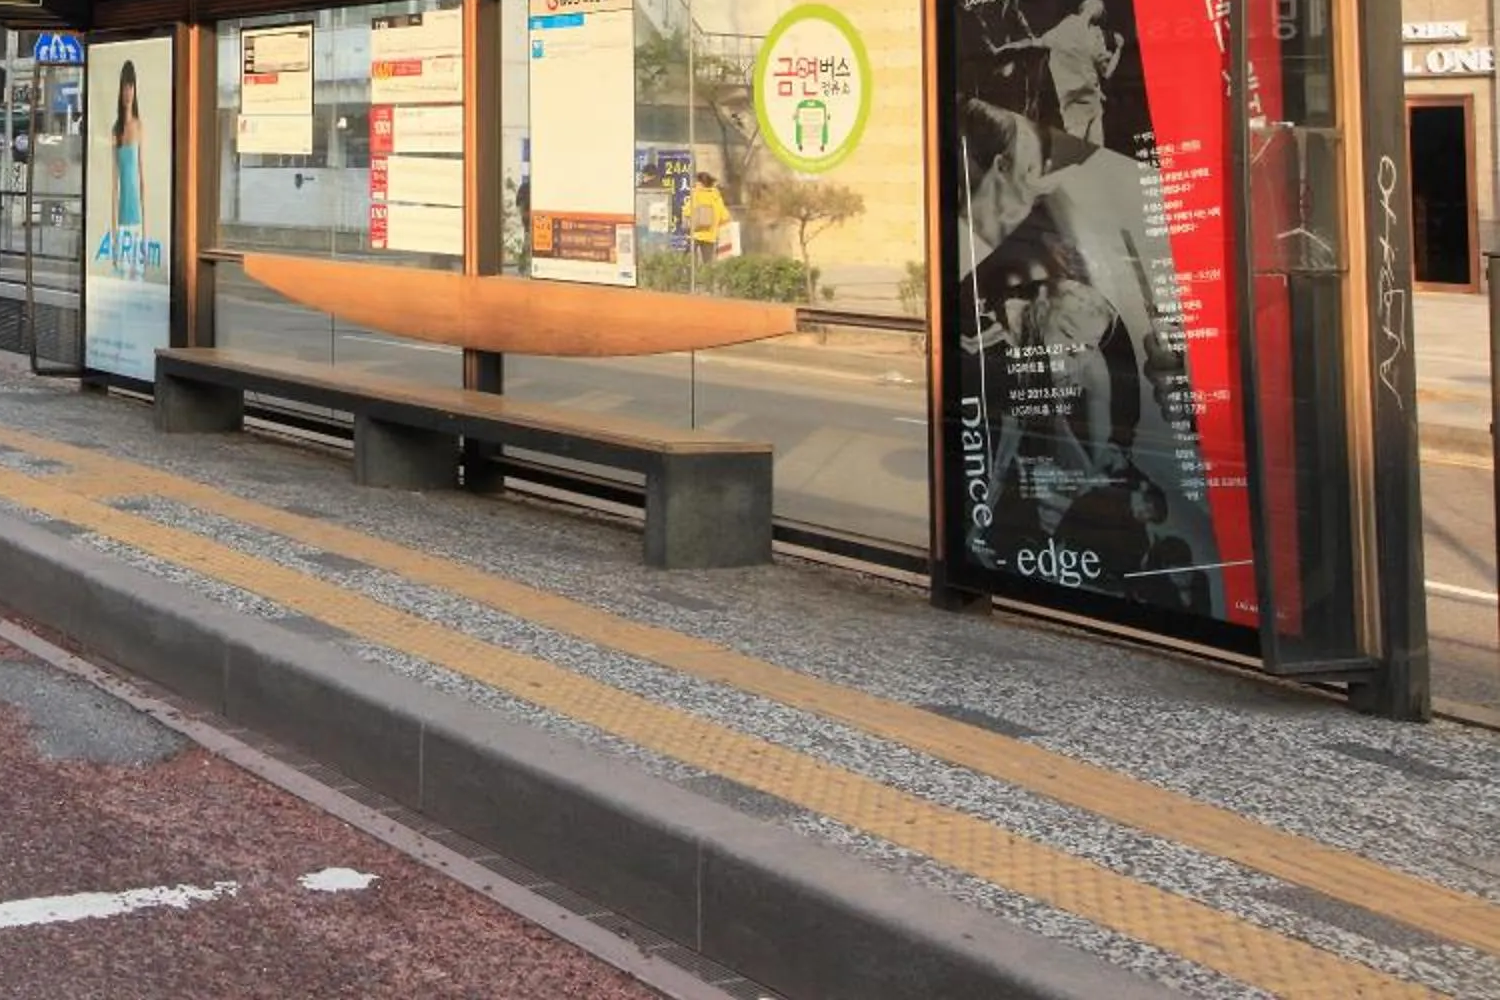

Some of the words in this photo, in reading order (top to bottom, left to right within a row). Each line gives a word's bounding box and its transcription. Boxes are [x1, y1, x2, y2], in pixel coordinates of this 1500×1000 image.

[773, 57, 818, 96] 금연
[819, 56, 851, 78] 버스
[822, 81, 851, 97] 정류소
[1016, 537, 1101, 588] edge
